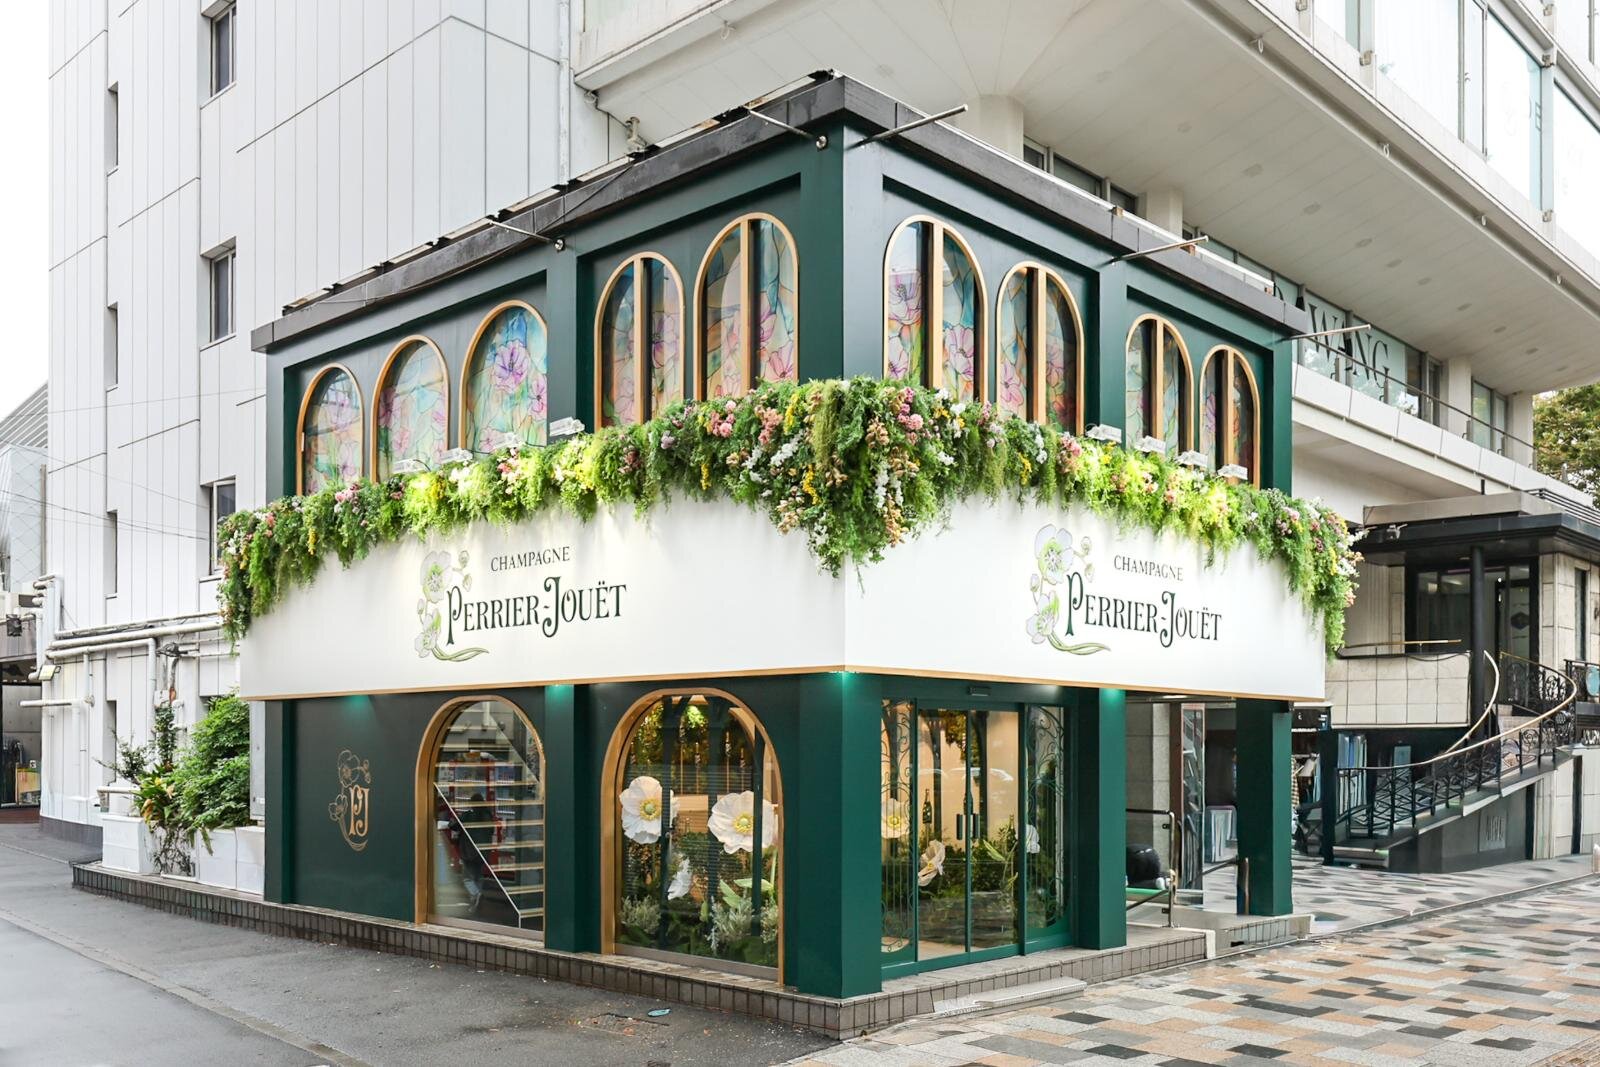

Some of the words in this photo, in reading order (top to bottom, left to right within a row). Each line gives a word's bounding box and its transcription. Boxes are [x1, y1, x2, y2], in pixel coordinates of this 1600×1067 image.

[490, 546, 571, 572] CHAMPAGNE
[1113, 554, 1184, 582] CHAMPAGNE
[446, 576, 627, 646] PERRIER-JOUËT
[1065, 571, 1222, 648] PERRIER-JOUËT
